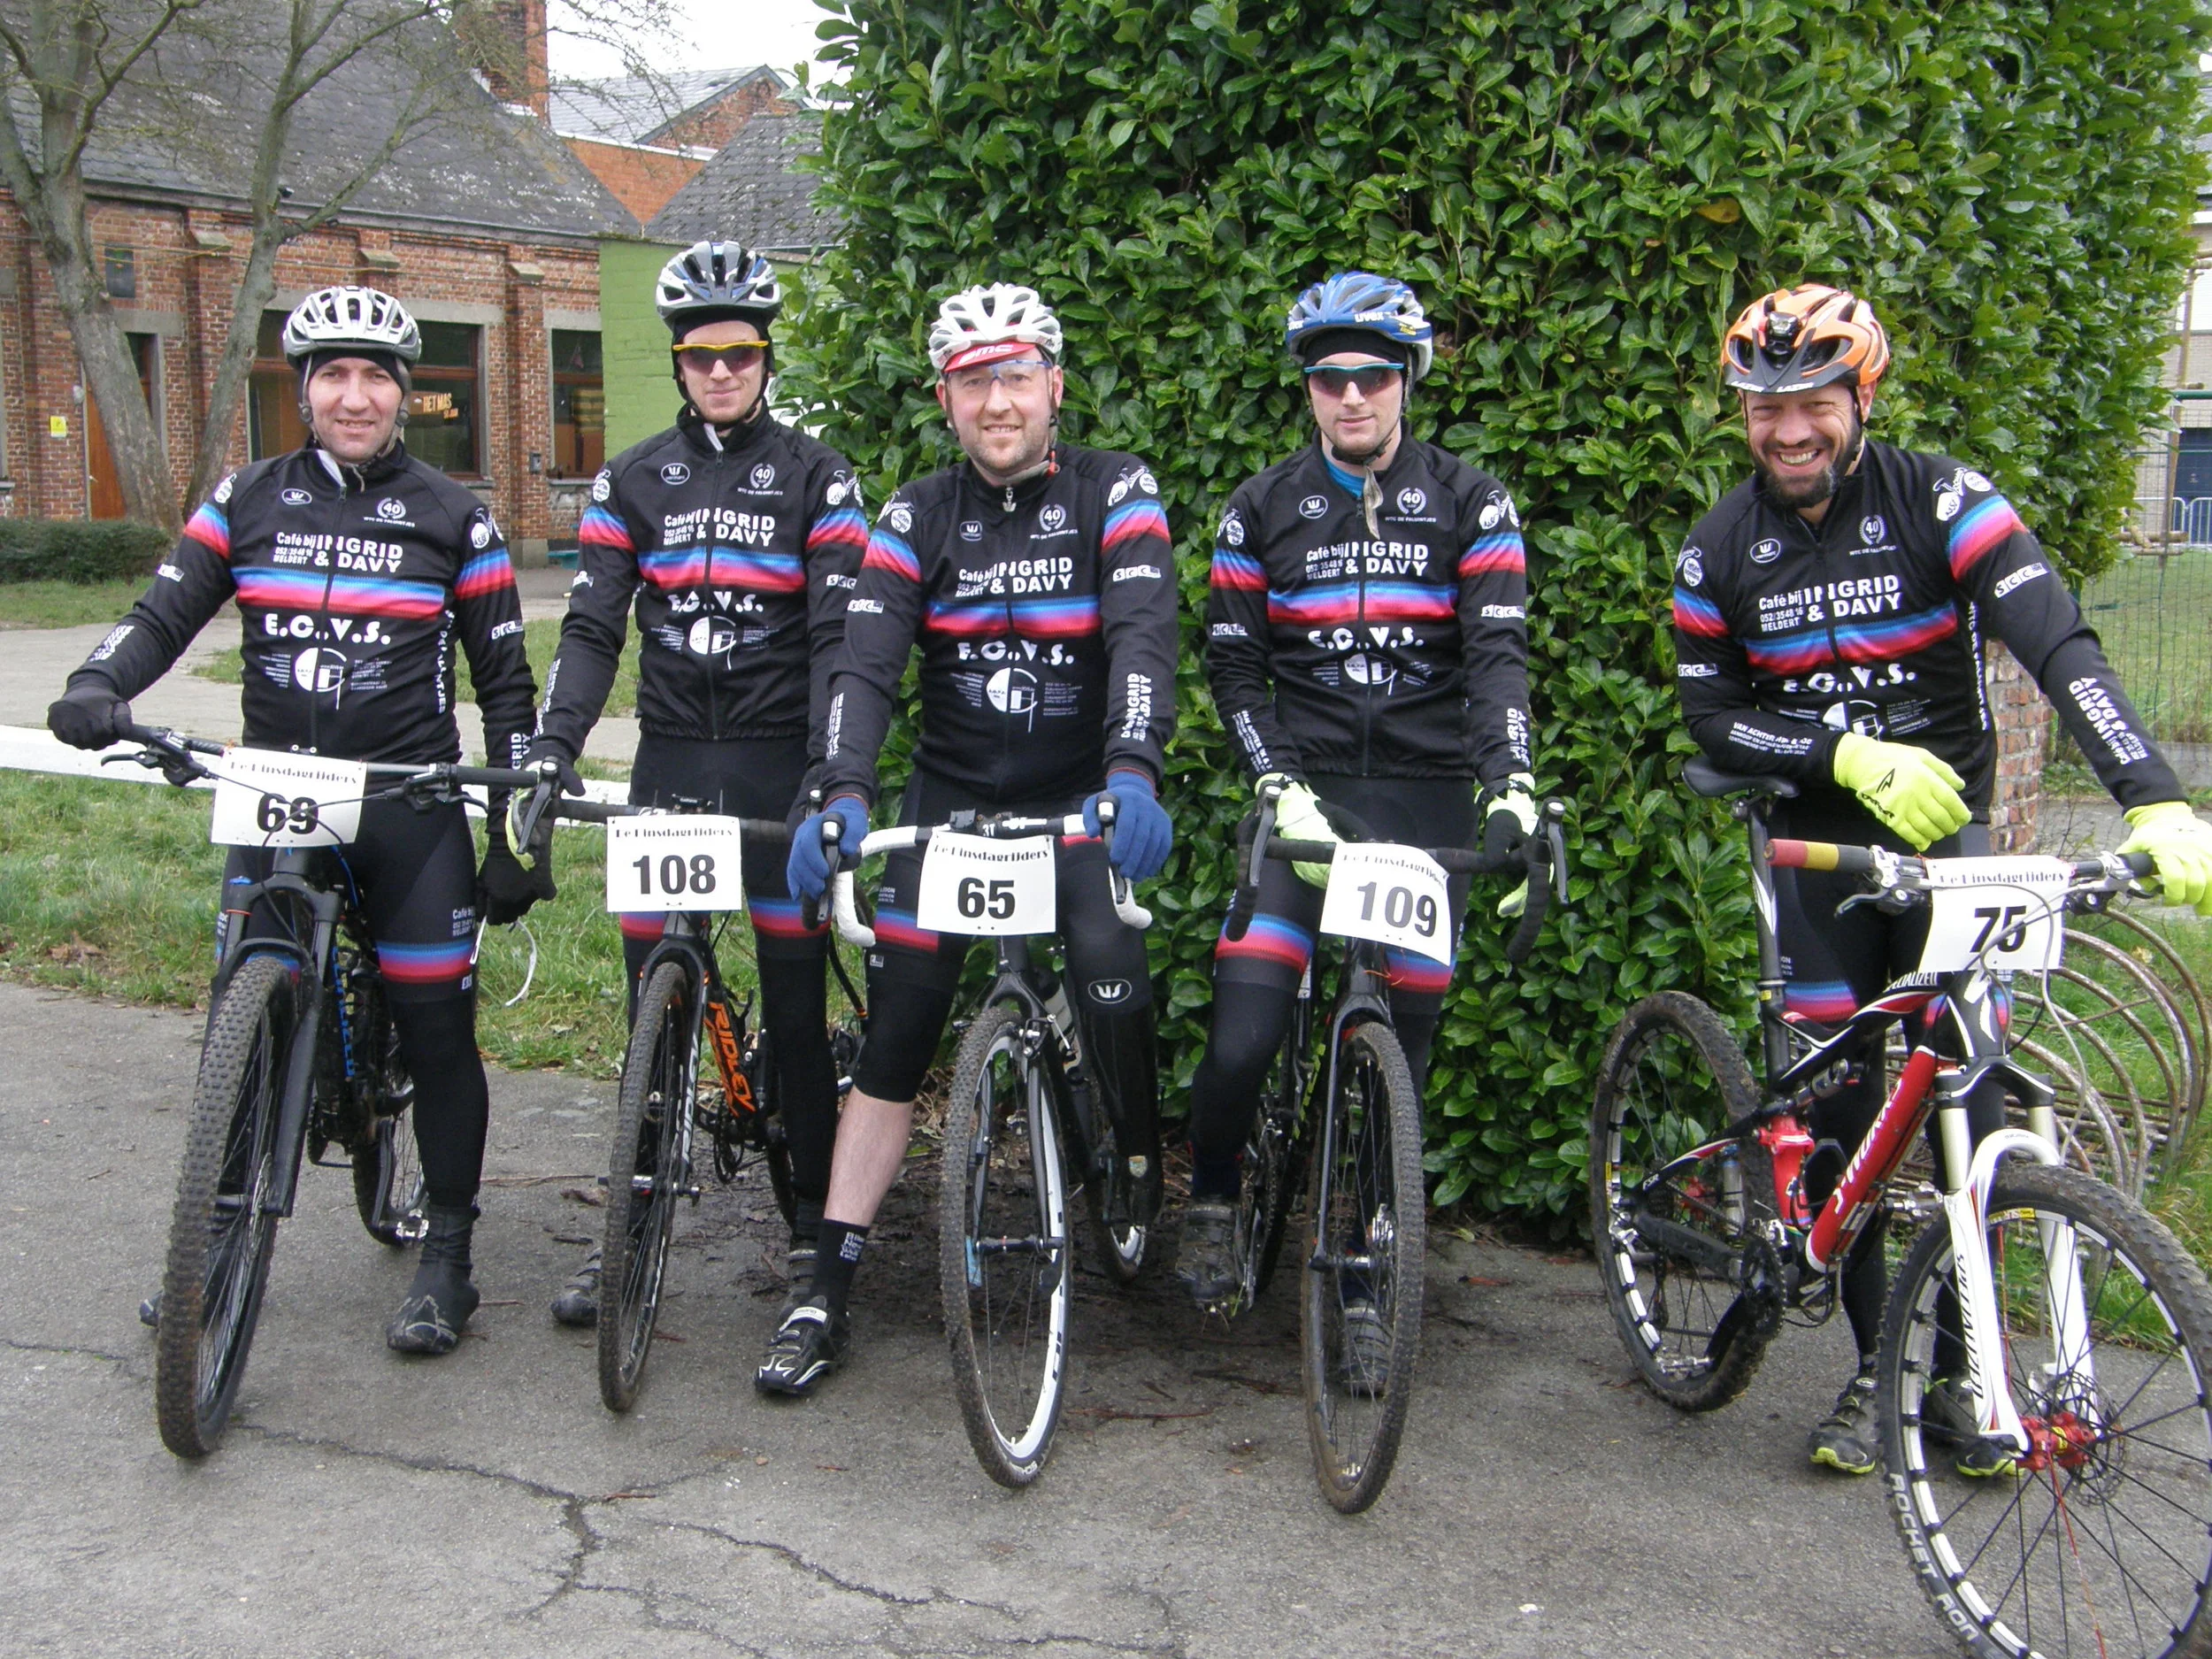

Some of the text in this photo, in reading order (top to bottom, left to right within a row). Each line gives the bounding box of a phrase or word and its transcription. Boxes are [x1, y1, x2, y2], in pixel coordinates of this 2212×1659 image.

[756, 468, 771, 480] 40
[383, 502, 401, 514] 40
[1403, 492, 1421, 503] 40
[1044, 510, 1061, 521] 40
[696, 524, 707, 540] &
[715, 523, 775, 547] DAVY
[1865, 521, 1879, 534] 40
[276, 531, 303, 547] Café
[314, 550, 402, 573] & DAVY
[1345, 557, 1428, 577] & DAVY
[990, 578, 1006, 595] &
[1012, 573, 1073, 594] DAVY
[1759, 594, 1786, 611] Café
[1807, 592, 1901, 622] & DAVY
[1761, 617, 1801, 633] MELDERT
[2080, 678, 2121, 720] DAVY
[257, 793, 319, 835] 69
[633, 854, 717, 895] 108
[957, 877, 1016, 920] 65
[1357, 880, 1438, 938] 109
[1970, 905, 2027, 953] 75
[1642, 1173, 1659, 1191] FSR
[1889, 1472, 1939, 1578] ROCKET
